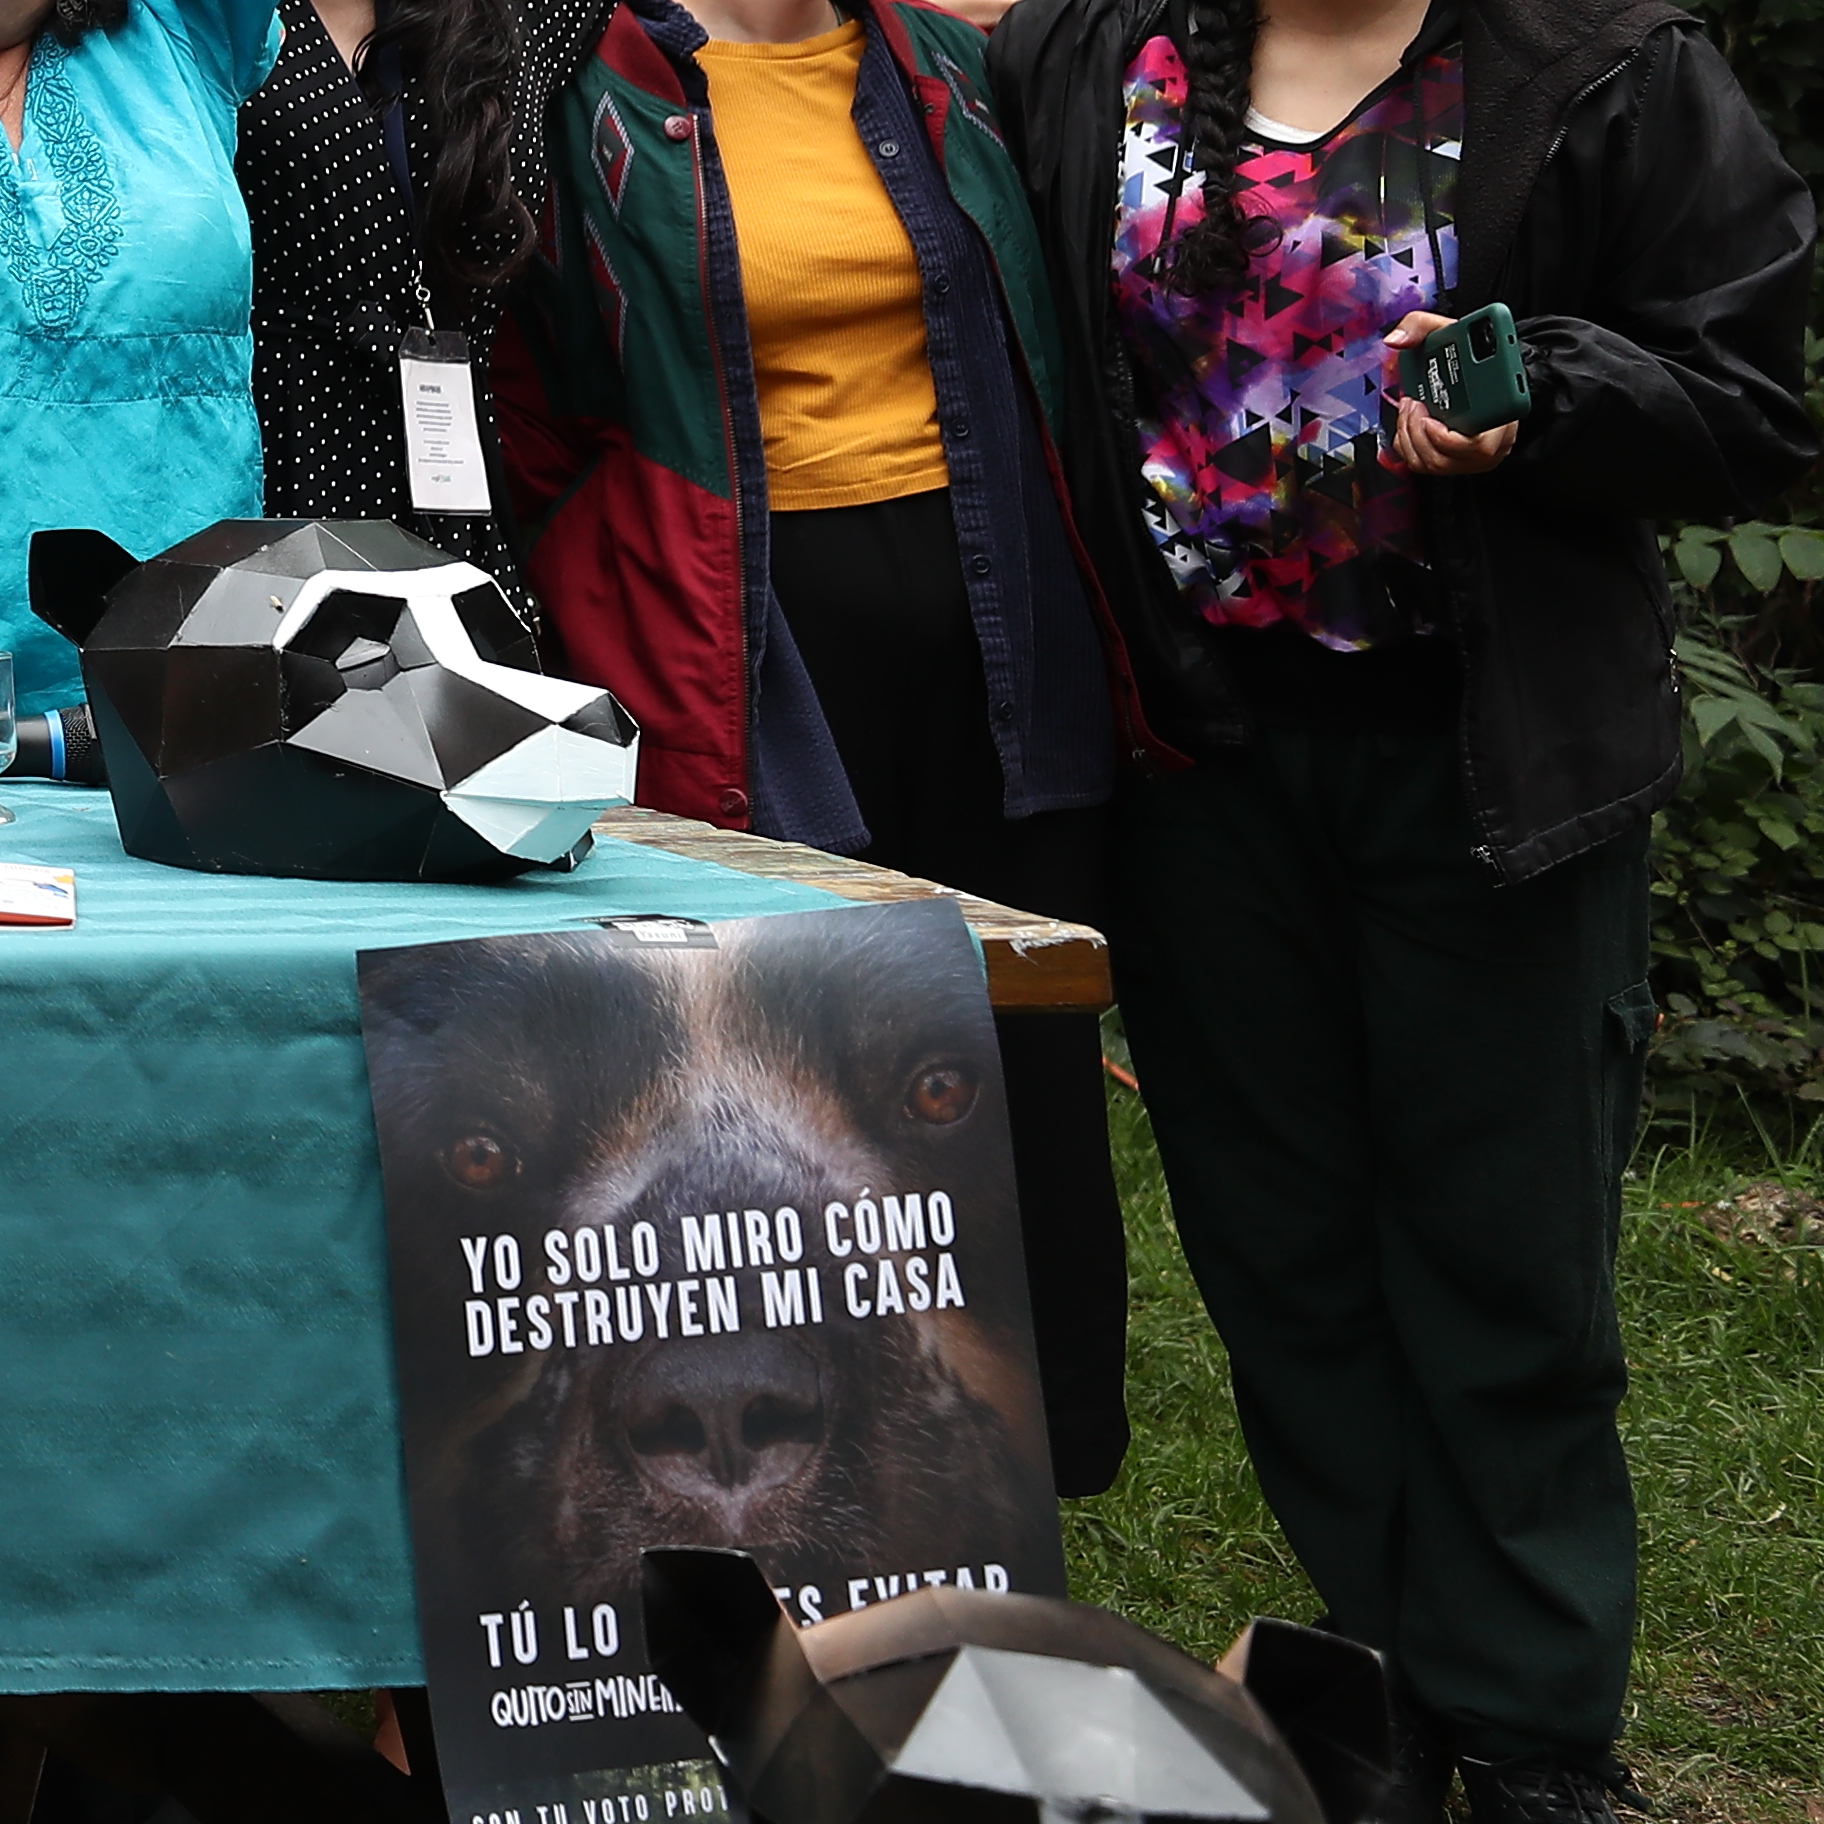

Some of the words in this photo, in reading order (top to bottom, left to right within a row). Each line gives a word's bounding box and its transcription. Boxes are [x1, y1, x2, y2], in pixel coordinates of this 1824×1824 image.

[461, 1235, 520, 1292] YO
[543, 1221, 658, 1286] SOLO
[681, 1207, 803, 1272] MIRO
[825, 1186, 955, 1252] CÓMO
[465, 1276, 740, 1357] DESTRUYEN
[762, 1267, 823, 1329] MI
[844, 1252, 965, 1317] CASA
[479, 1599, 539, 1668] TÚ
[562, 1602, 619, 1661] LO
[491, 1682, 566, 1728] QUITO
[595, 1674, 683, 1716] MINE
[583, 1792, 649, 1823] VOTO
